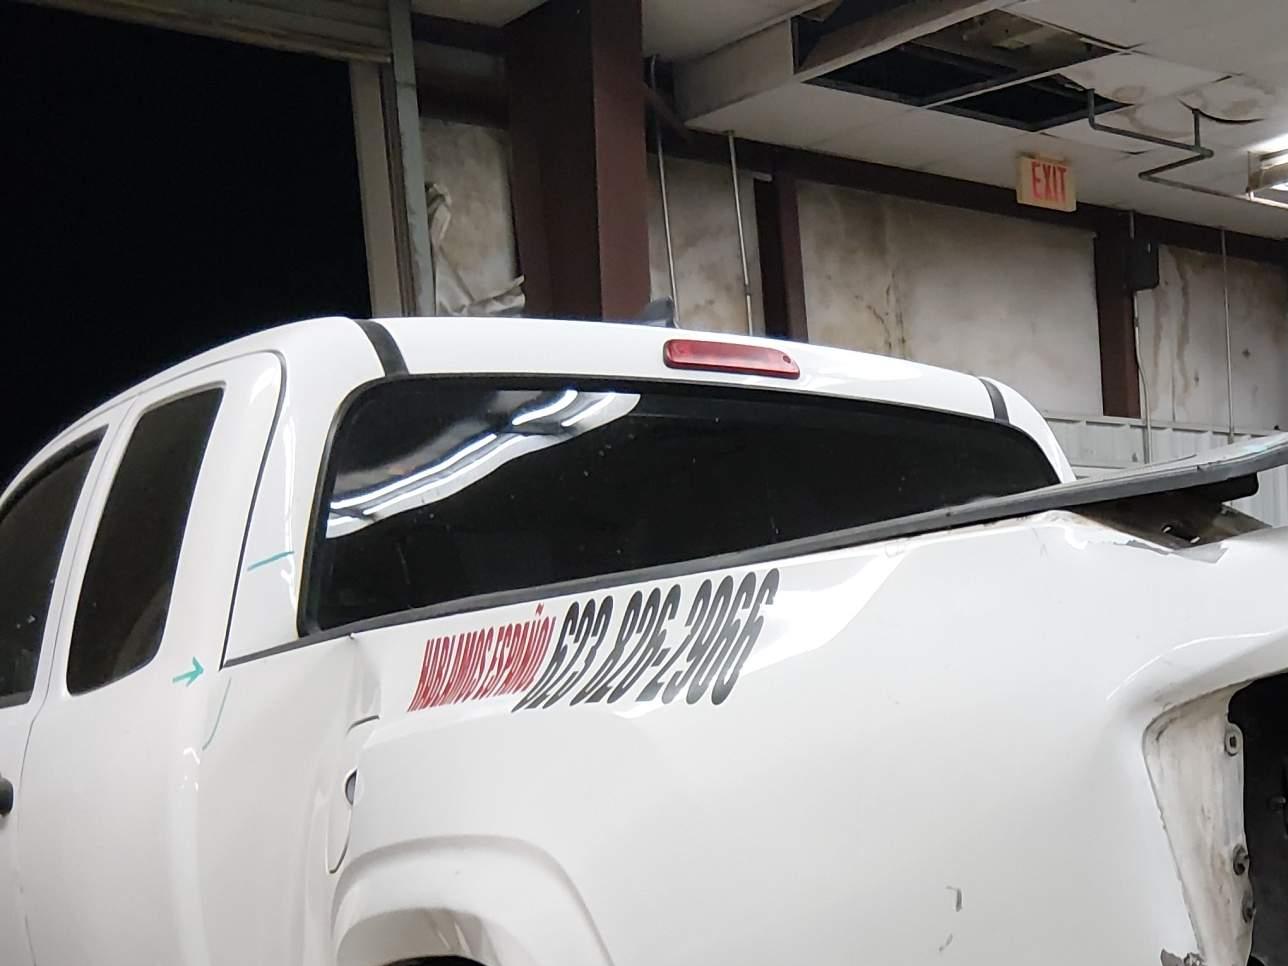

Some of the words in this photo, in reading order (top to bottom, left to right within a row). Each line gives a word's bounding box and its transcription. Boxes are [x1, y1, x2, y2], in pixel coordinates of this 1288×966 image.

[1031, 160, 1067, 204] EXIT
[407, 626, 495, 712] HABLAMOS
[511, 595, 614, 713] 623
[569, 567, 780, 706] 826-2966
